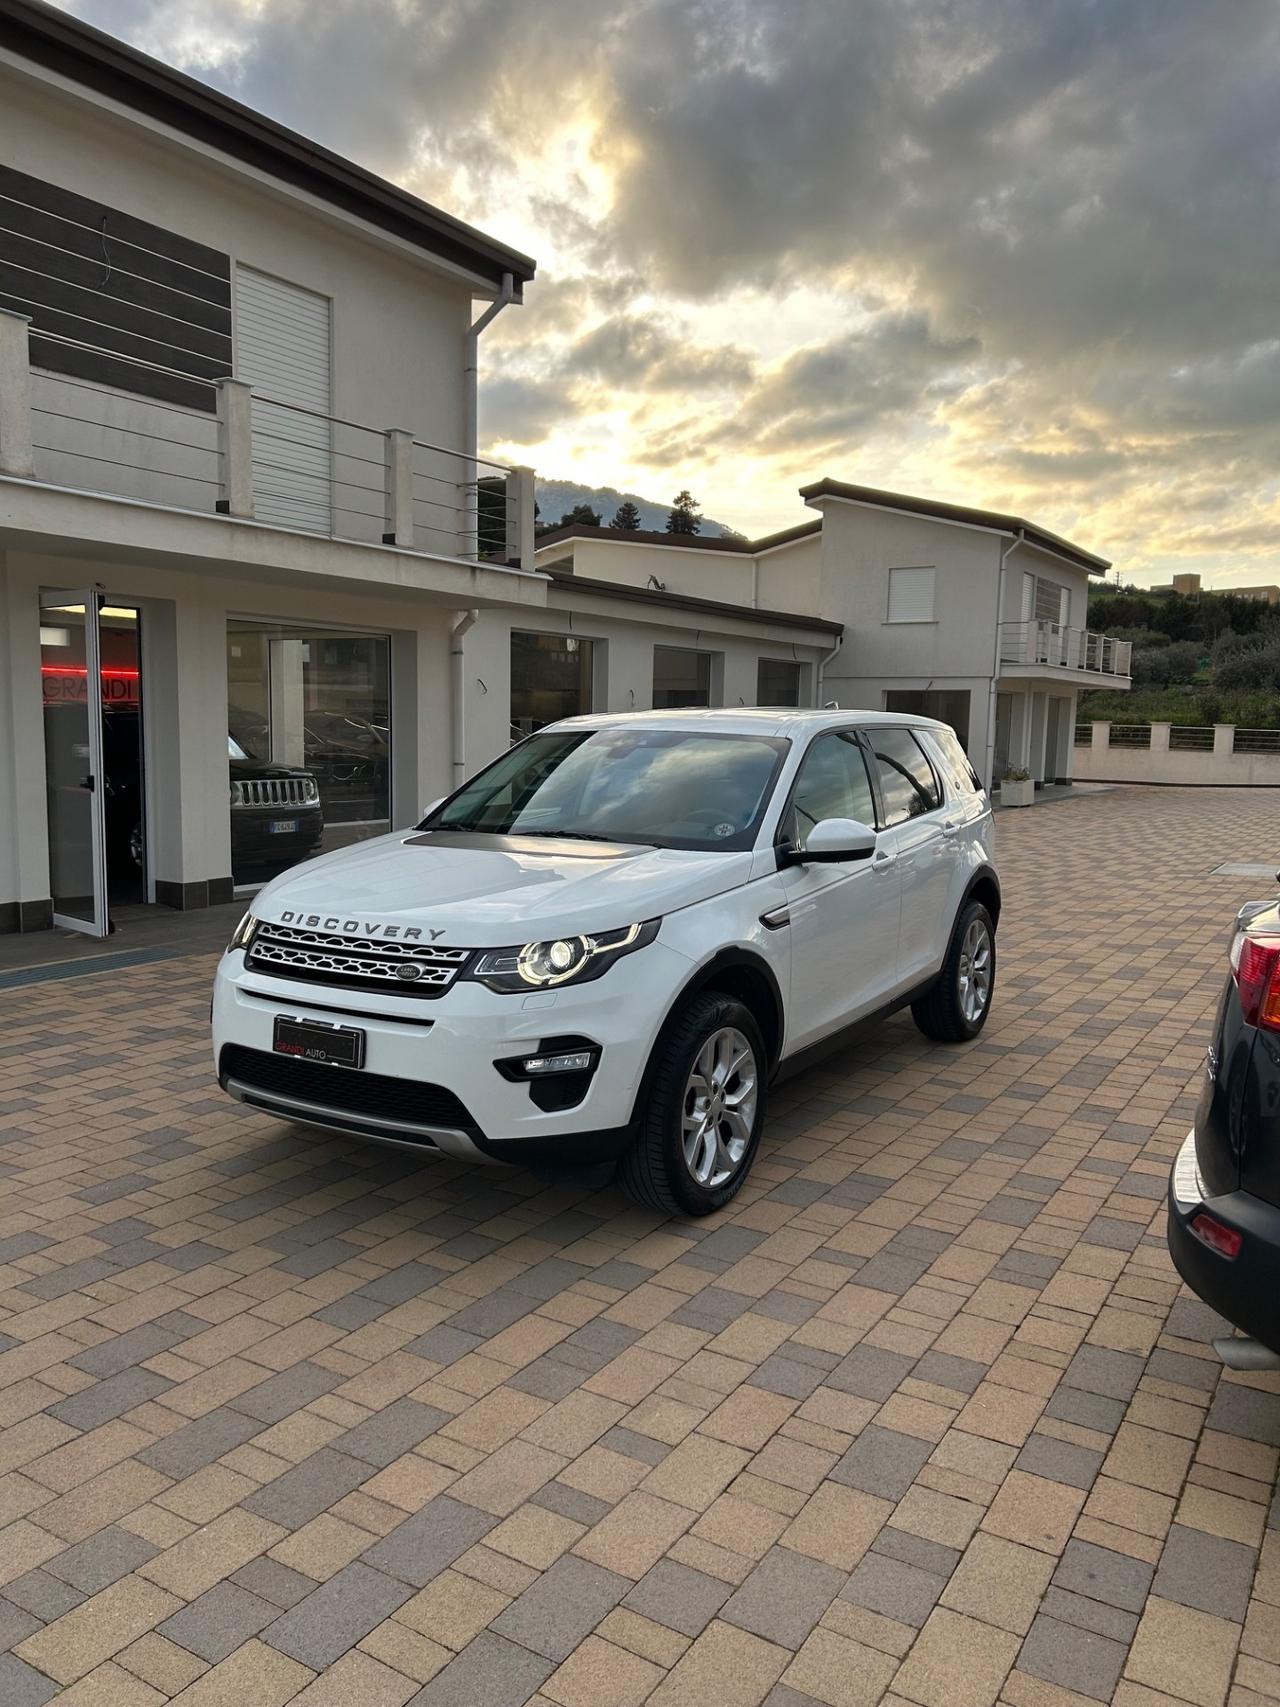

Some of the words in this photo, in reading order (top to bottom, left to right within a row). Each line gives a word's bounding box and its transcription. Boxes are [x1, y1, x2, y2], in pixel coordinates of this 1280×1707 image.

[280, 911, 446, 941] DISCOVERY
[276, 1041, 304, 1055] GRANDI
[305, 1048, 326, 1060] AUTO
